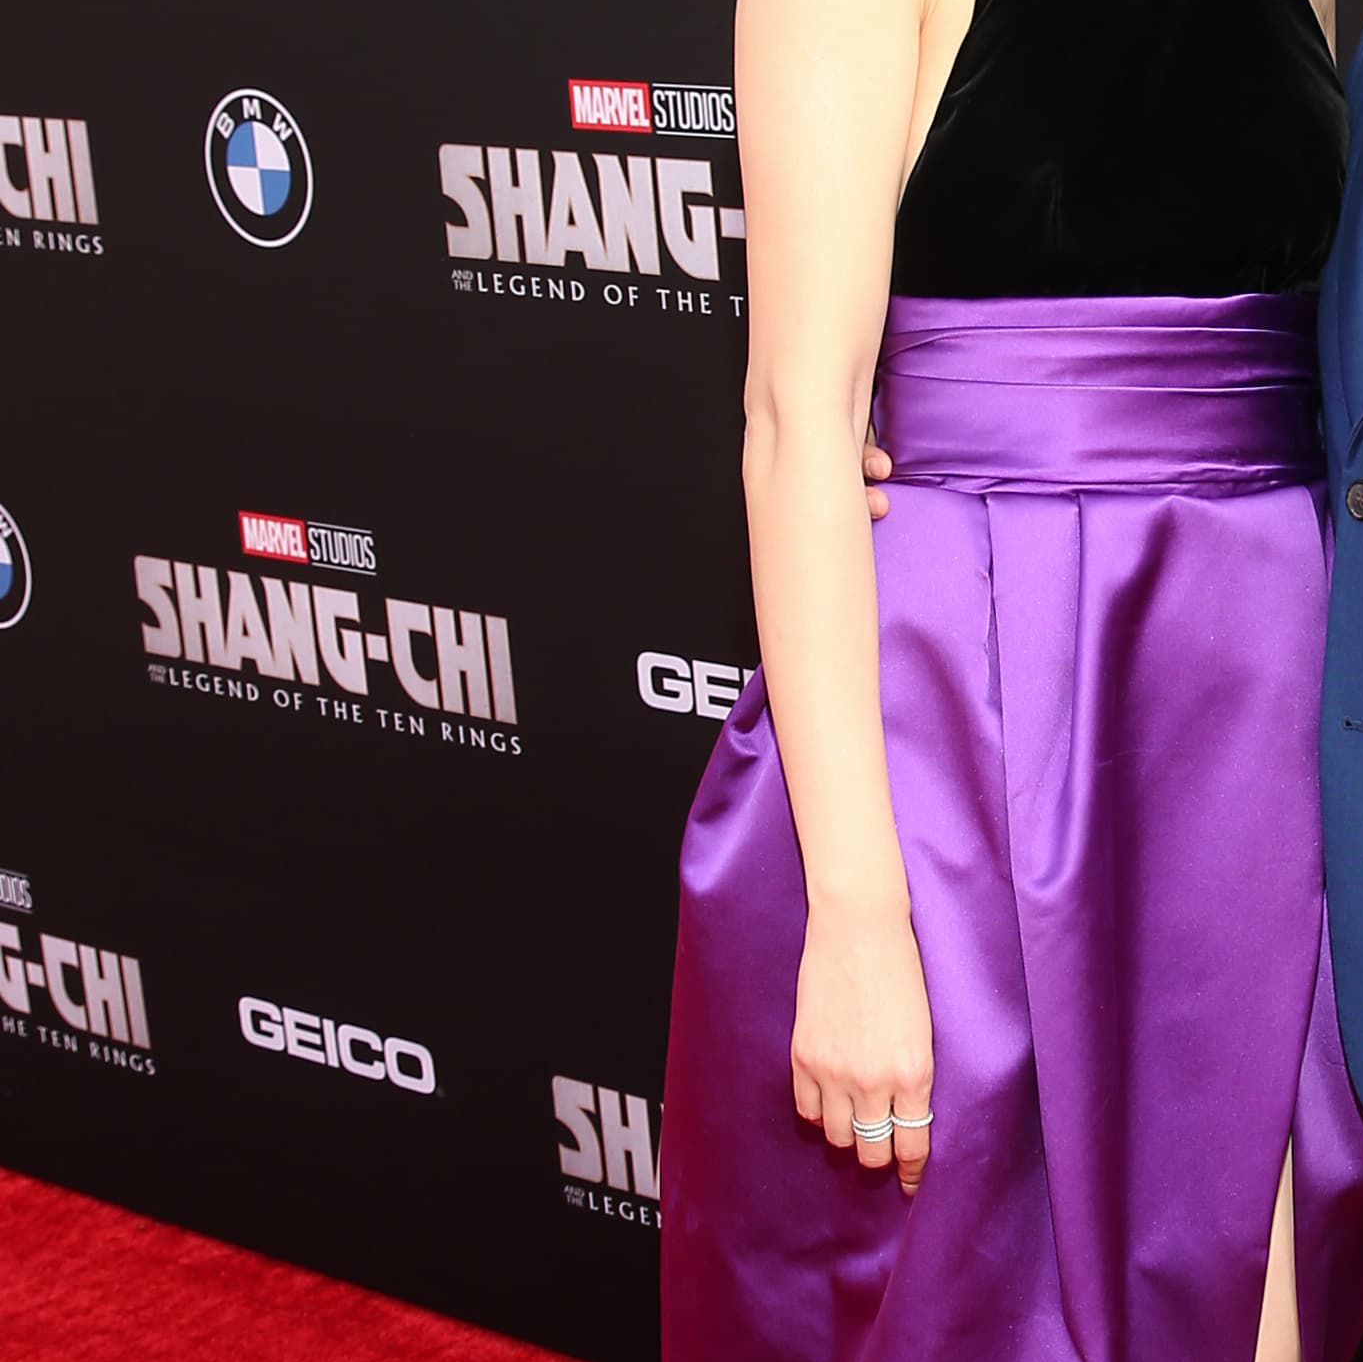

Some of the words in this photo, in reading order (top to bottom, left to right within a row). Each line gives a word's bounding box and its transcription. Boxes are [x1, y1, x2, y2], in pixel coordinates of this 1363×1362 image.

[215, 98, 293, 141] BMW
[573, 85, 650, 127] MARVEL
[653, 90, 735, 132] STUDIOS
[439, 144, 746, 280] SHANG-
[33, 231, 103, 254] RINGS
[477, 272, 585, 301] LEGEND
[604, 285, 638, 306] OF
[656, 289, 711, 314] THE
[242, 517, 307, 558] MARVEL
[308, 528, 376, 569] STUDIOS
[135, 556, 516, 724] SHANG-CHI
[169, 668, 258, 701] LEGEND
[274, 690, 301, 710] OF
[317, 697, 362, 723] THE
[377, 709, 424, 735] TEN
[442, 722, 521, 754] RINGS
[2, 1017, 26, 1036] HE
[38, 1026, 78, 1052] TEN
[89, 1042, 155, 1075] RINGS
[239, 997, 435, 1093] GEICO
